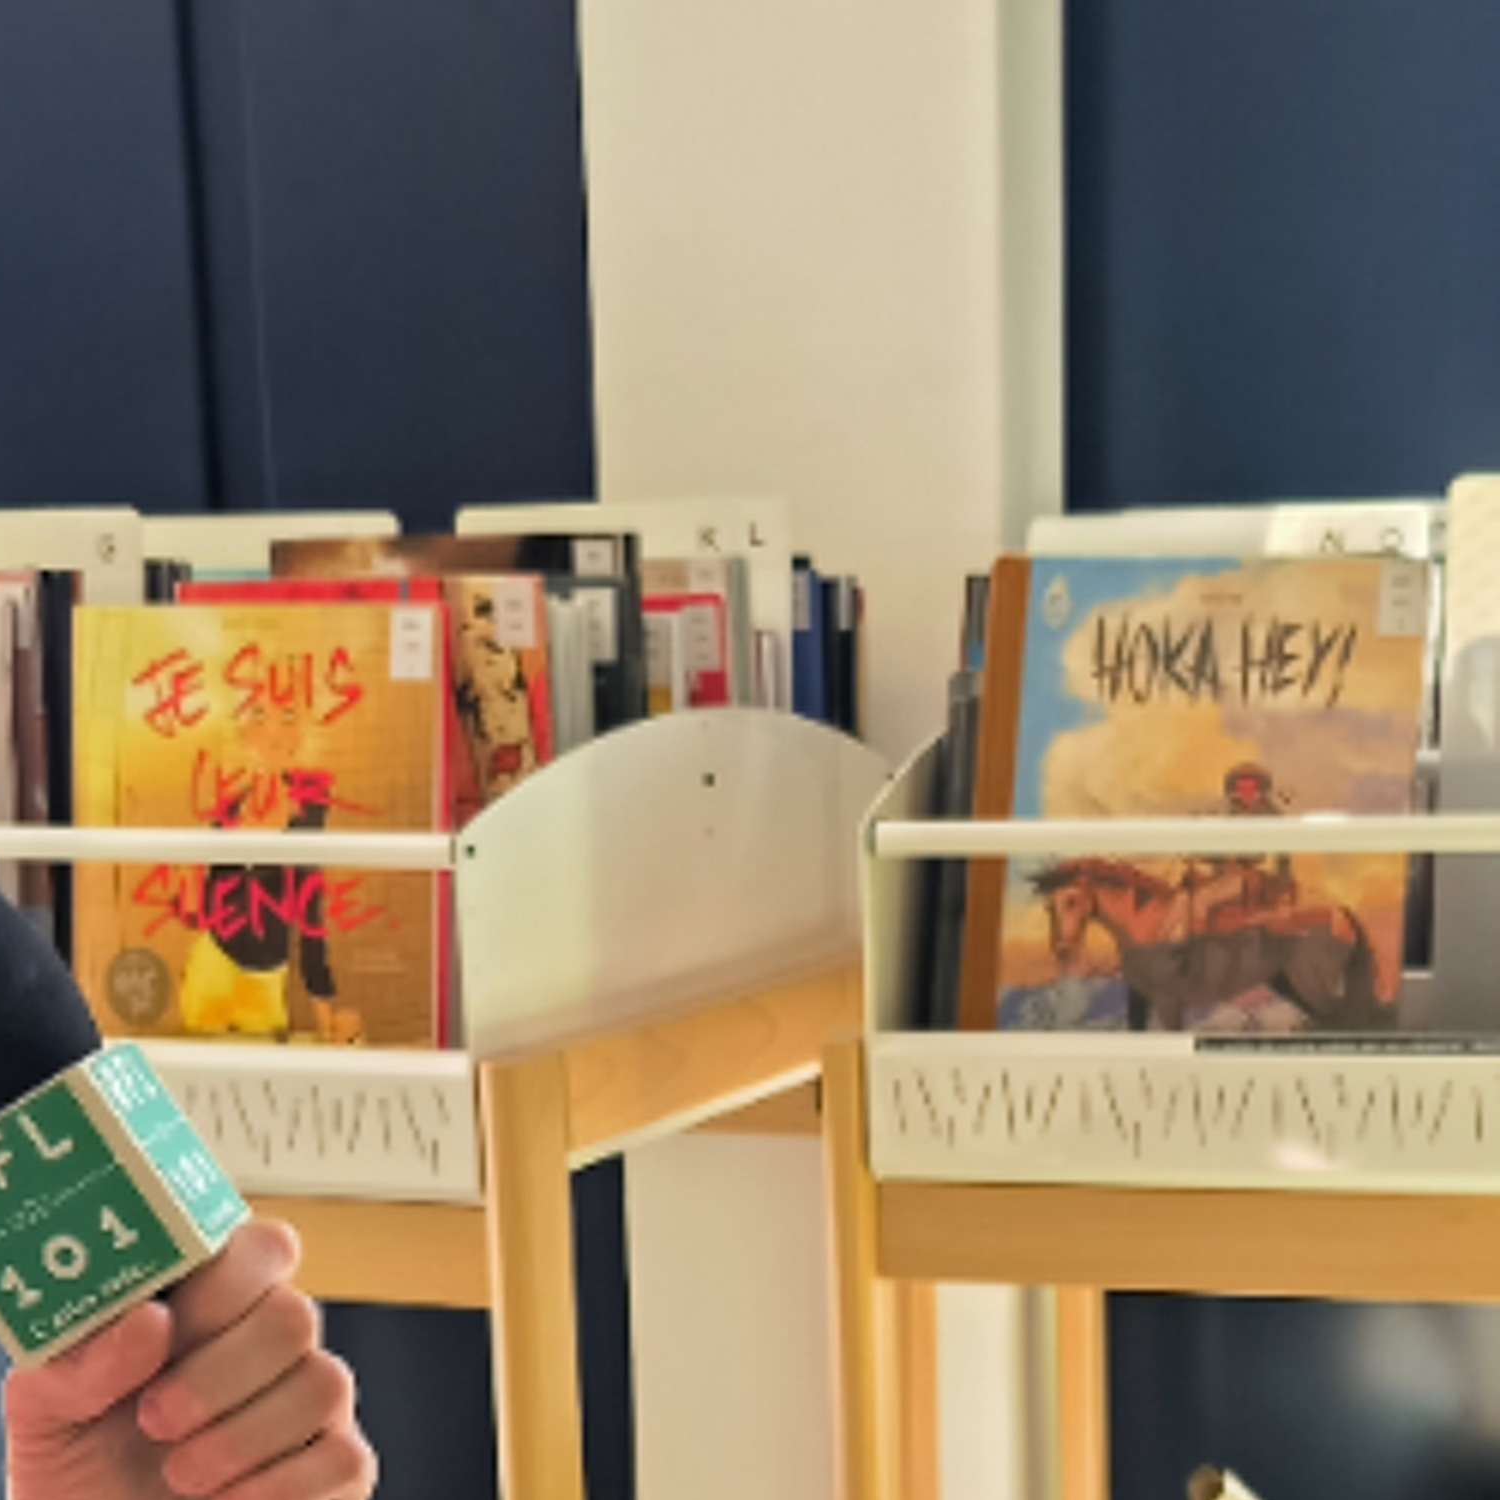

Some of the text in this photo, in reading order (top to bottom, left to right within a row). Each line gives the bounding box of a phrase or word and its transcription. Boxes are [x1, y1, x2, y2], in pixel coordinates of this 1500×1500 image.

[748, 520, 767, 548] L
[132, 648, 209, 739] JE
[223, 642, 365, 727] SUIS
[1091, 612, 1358, 708] HOKA HEY!
[191, 749, 385, 830] LEUR
[0, 1206, 140, 1309] 101
